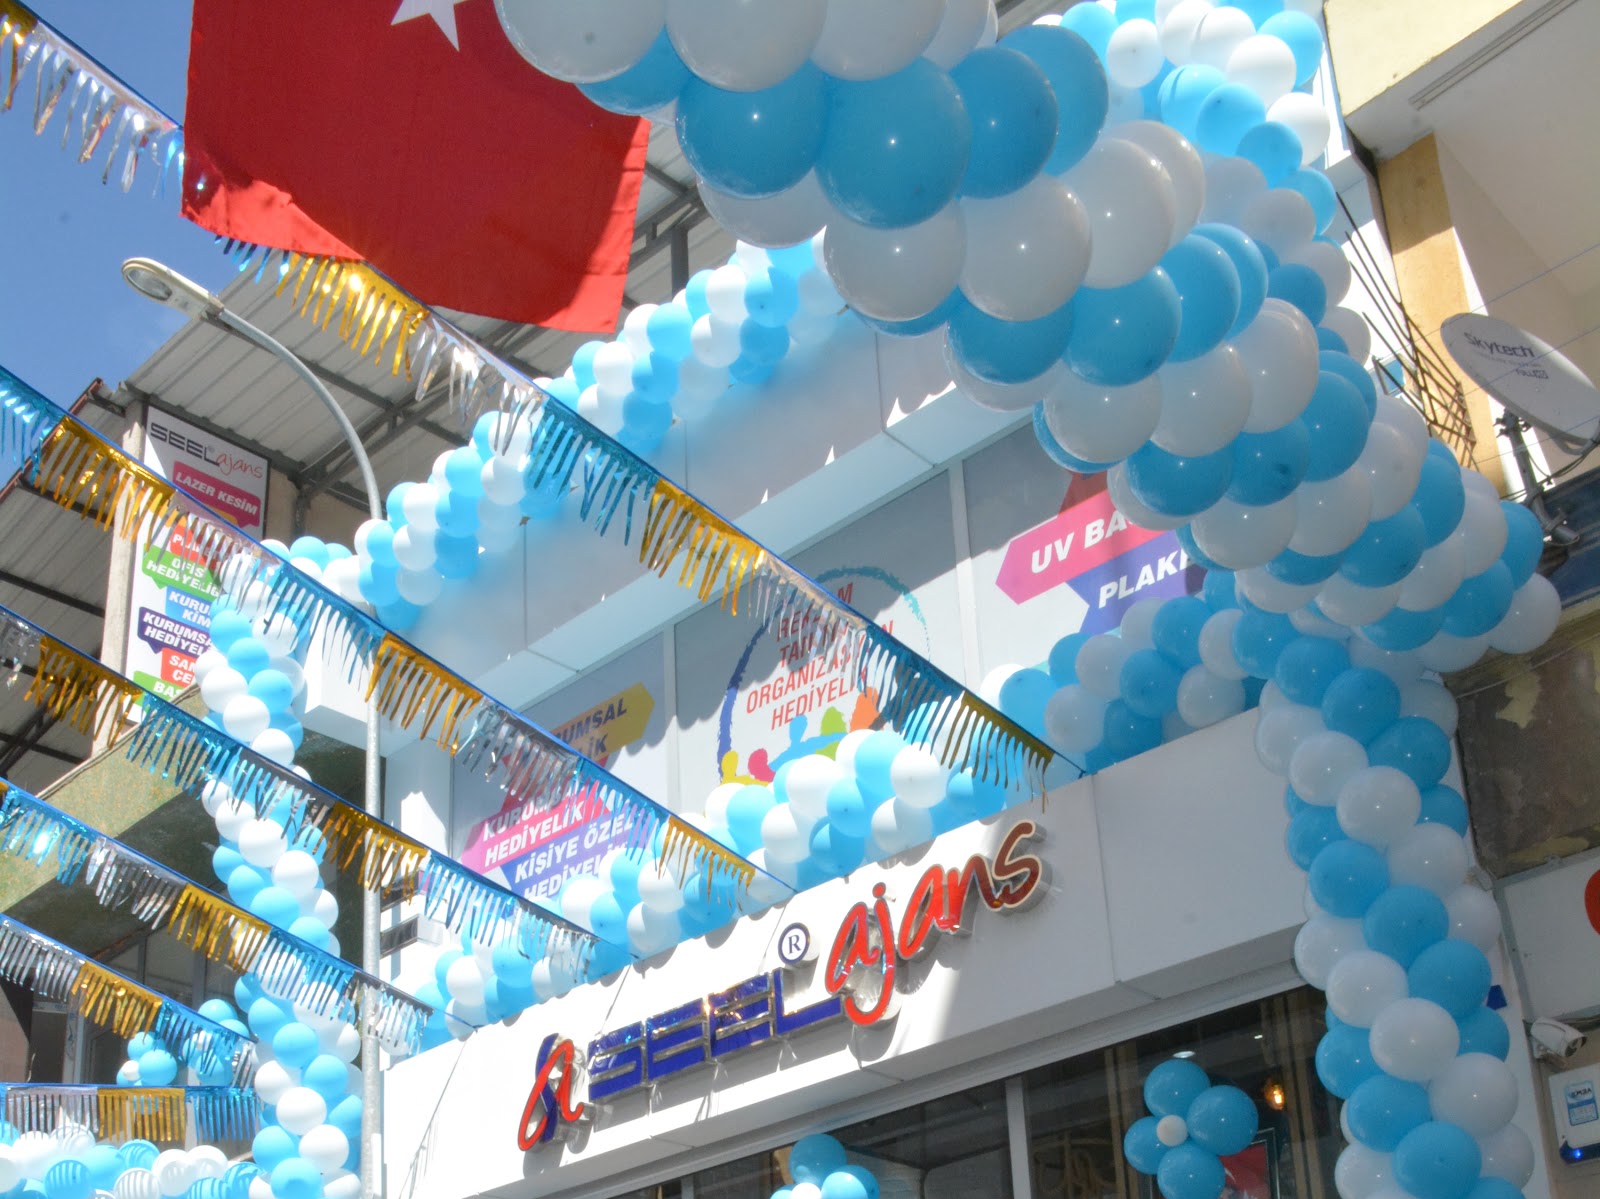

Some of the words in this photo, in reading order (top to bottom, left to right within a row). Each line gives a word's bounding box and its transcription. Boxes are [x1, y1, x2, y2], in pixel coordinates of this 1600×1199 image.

[1463, 332, 1535, 358] Skytech
[150, 422, 220, 467] SEEL
[215, 452, 264, 479] ajans
[175, 471, 215, 496] LAZER
[217, 487, 258, 516] KESİM
[1030, 532, 1075, 574] UV
[1084, 510, 1130, 549] BA
[142, 612, 213, 647] KURUMSA
[168, 590, 211, 616] KURU
[484, 800, 585, 867] HEDİYELİK
[514, 835, 579, 884] KİŞİYE
[583, 813, 634, 849] ÖZEL
[587, 966, 846, 1101] SEEL
[825, 820, 1042, 1027] ajans
